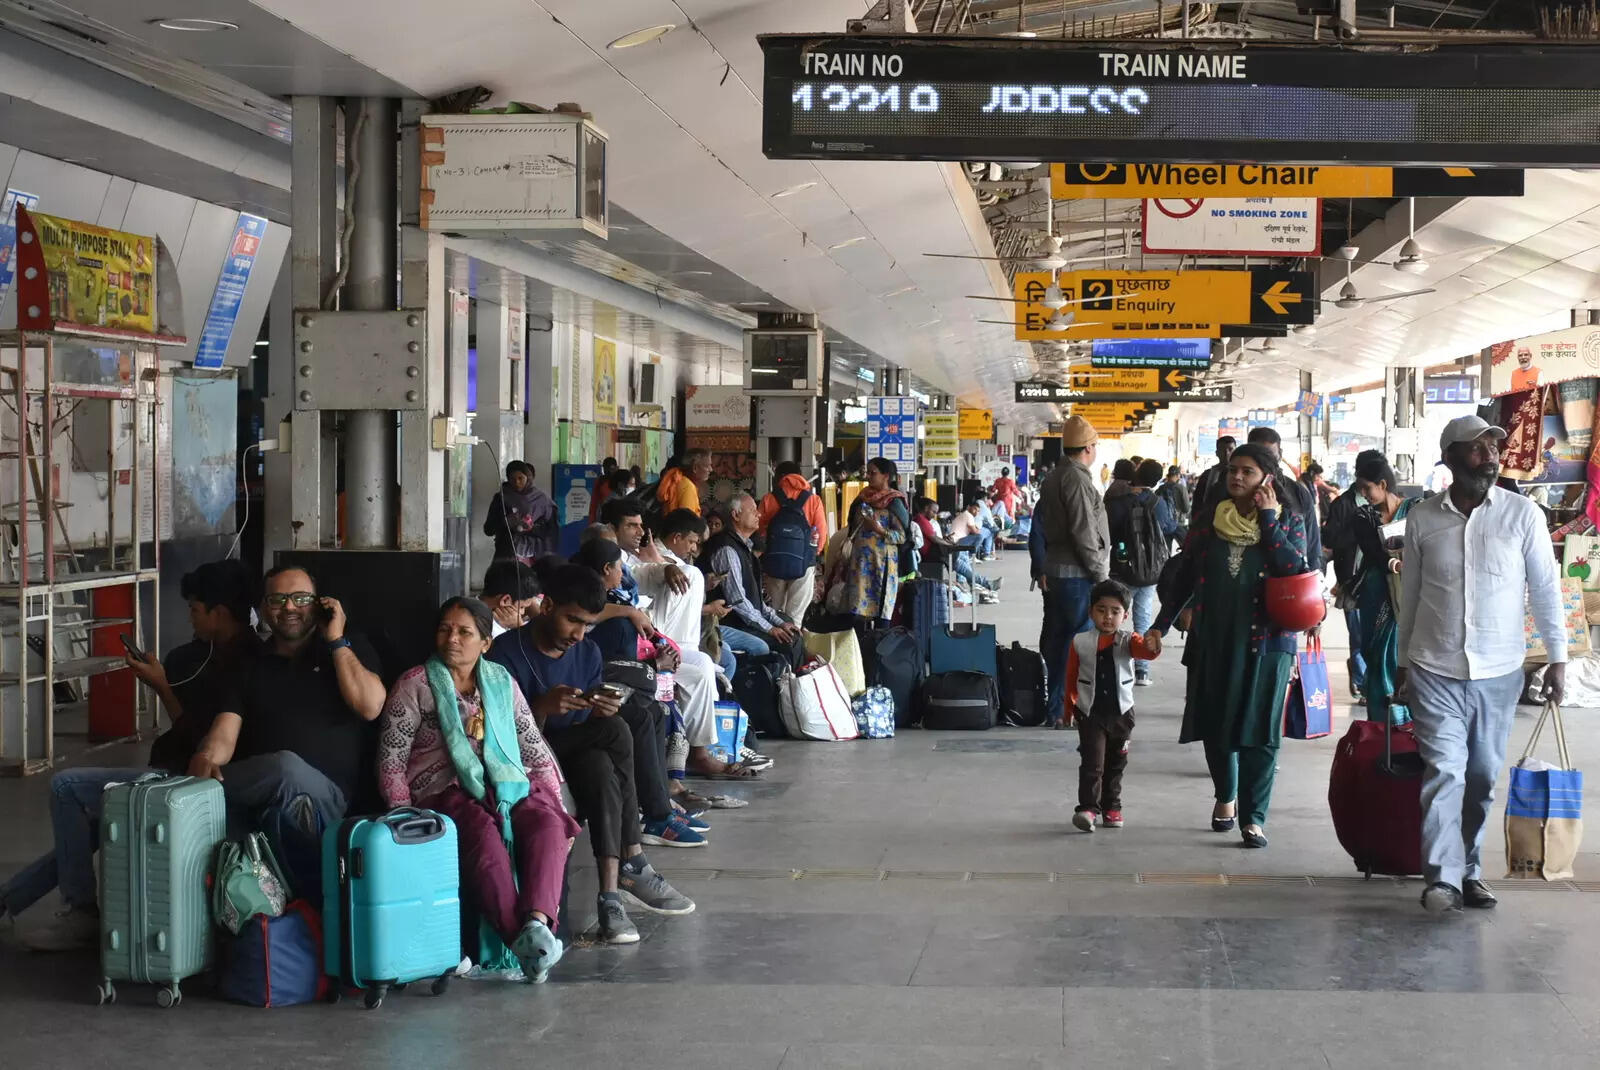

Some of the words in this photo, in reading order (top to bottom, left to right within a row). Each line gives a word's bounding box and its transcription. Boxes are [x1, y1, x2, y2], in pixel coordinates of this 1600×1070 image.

[804, 53, 865, 76] TRAIN
[872, 54, 904, 77] NO
[1099, 53, 1171, 77] TRAIN
[1177, 54, 1247, 78] NAME
[1135, 163, 1227, 185] Wheel
[1237, 164, 1320, 186] Chair
[1211, 209, 1226, 217] NO
[1229, 210, 1277, 218] SMOKING
[1280, 211, 1308, 219] ZONE
[42, 225, 69, 248] MULTI
[71, 231, 108, 257] PURPOSE
[109, 238, 132, 260] STALL
[1116, 279, 1171, 295] पूछताछ
[1116, 298, 1176, 314] Enquiry
[1113, 380, 1147, 389] Manager
